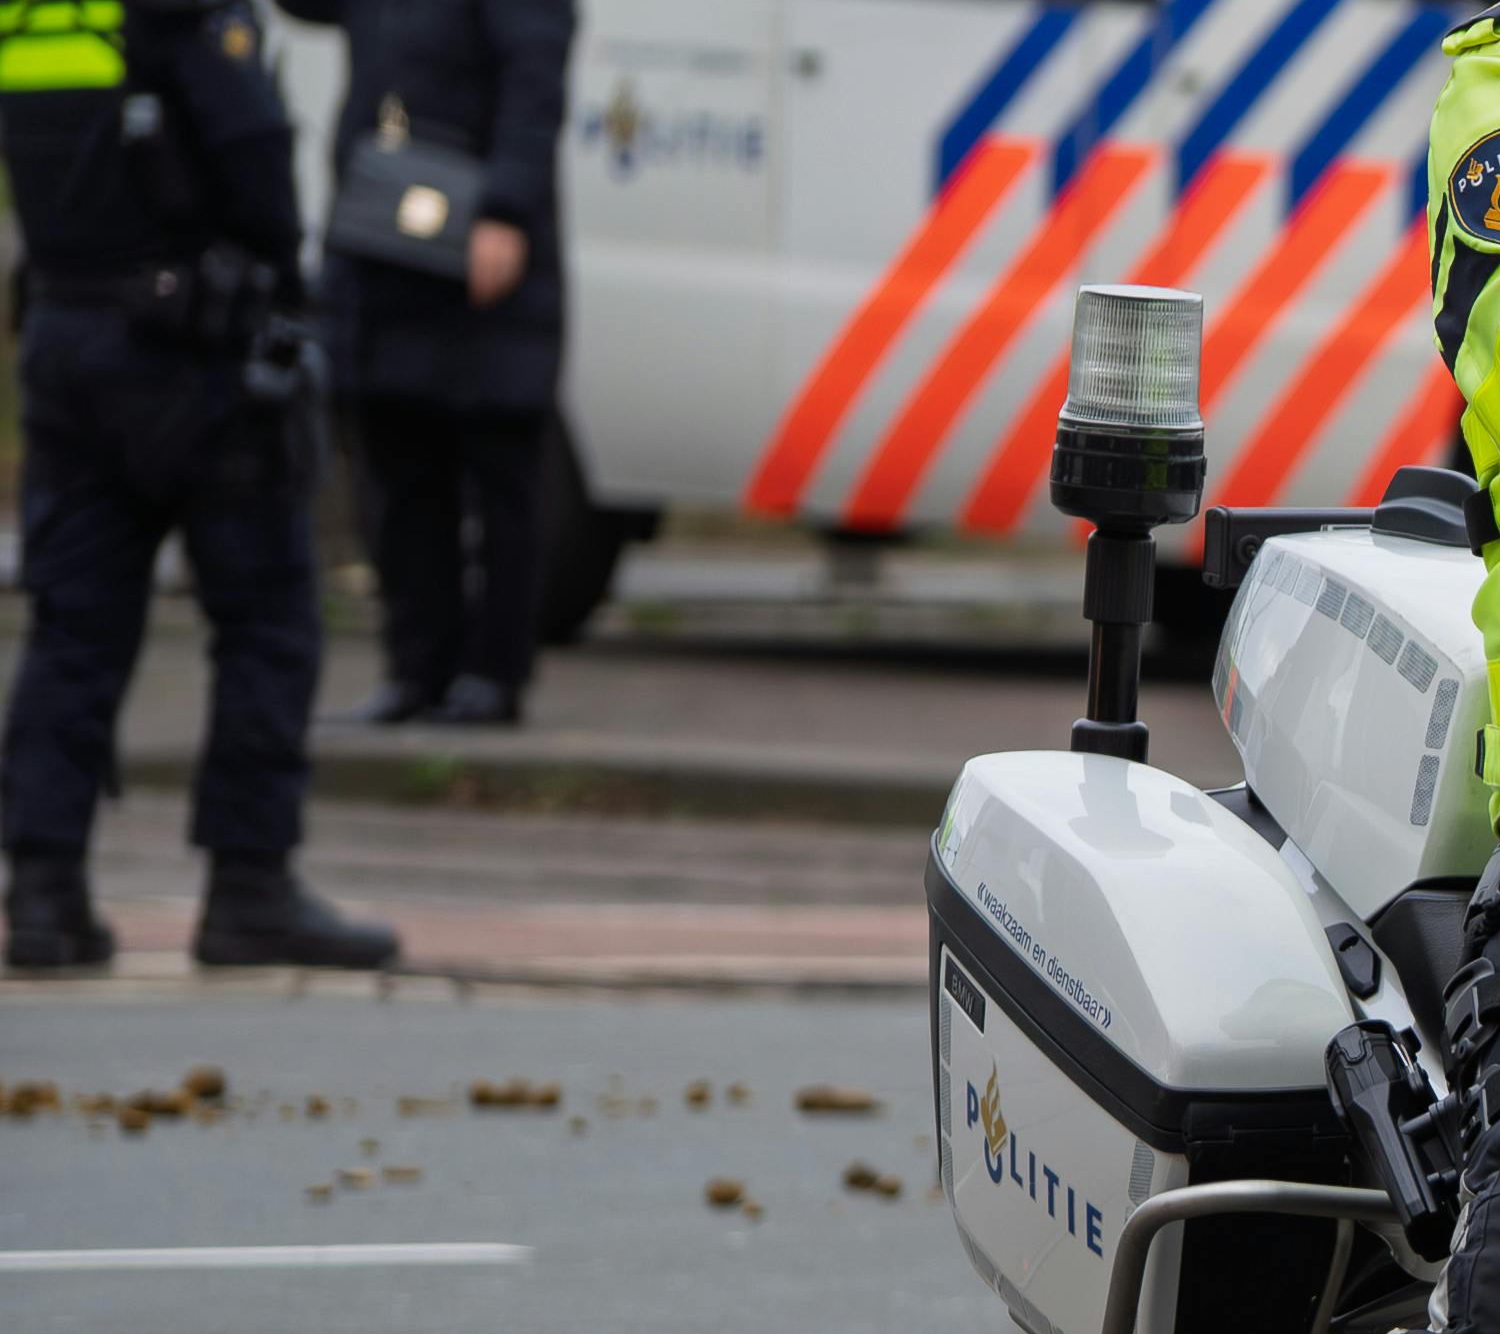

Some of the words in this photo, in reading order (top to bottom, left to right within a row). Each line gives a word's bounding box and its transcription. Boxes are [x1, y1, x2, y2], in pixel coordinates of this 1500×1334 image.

[1032, 943, 1046, 968] en
[951, 973, 976, 1015] BMW
[966, 1080, 1104, 1259] POLITIE
